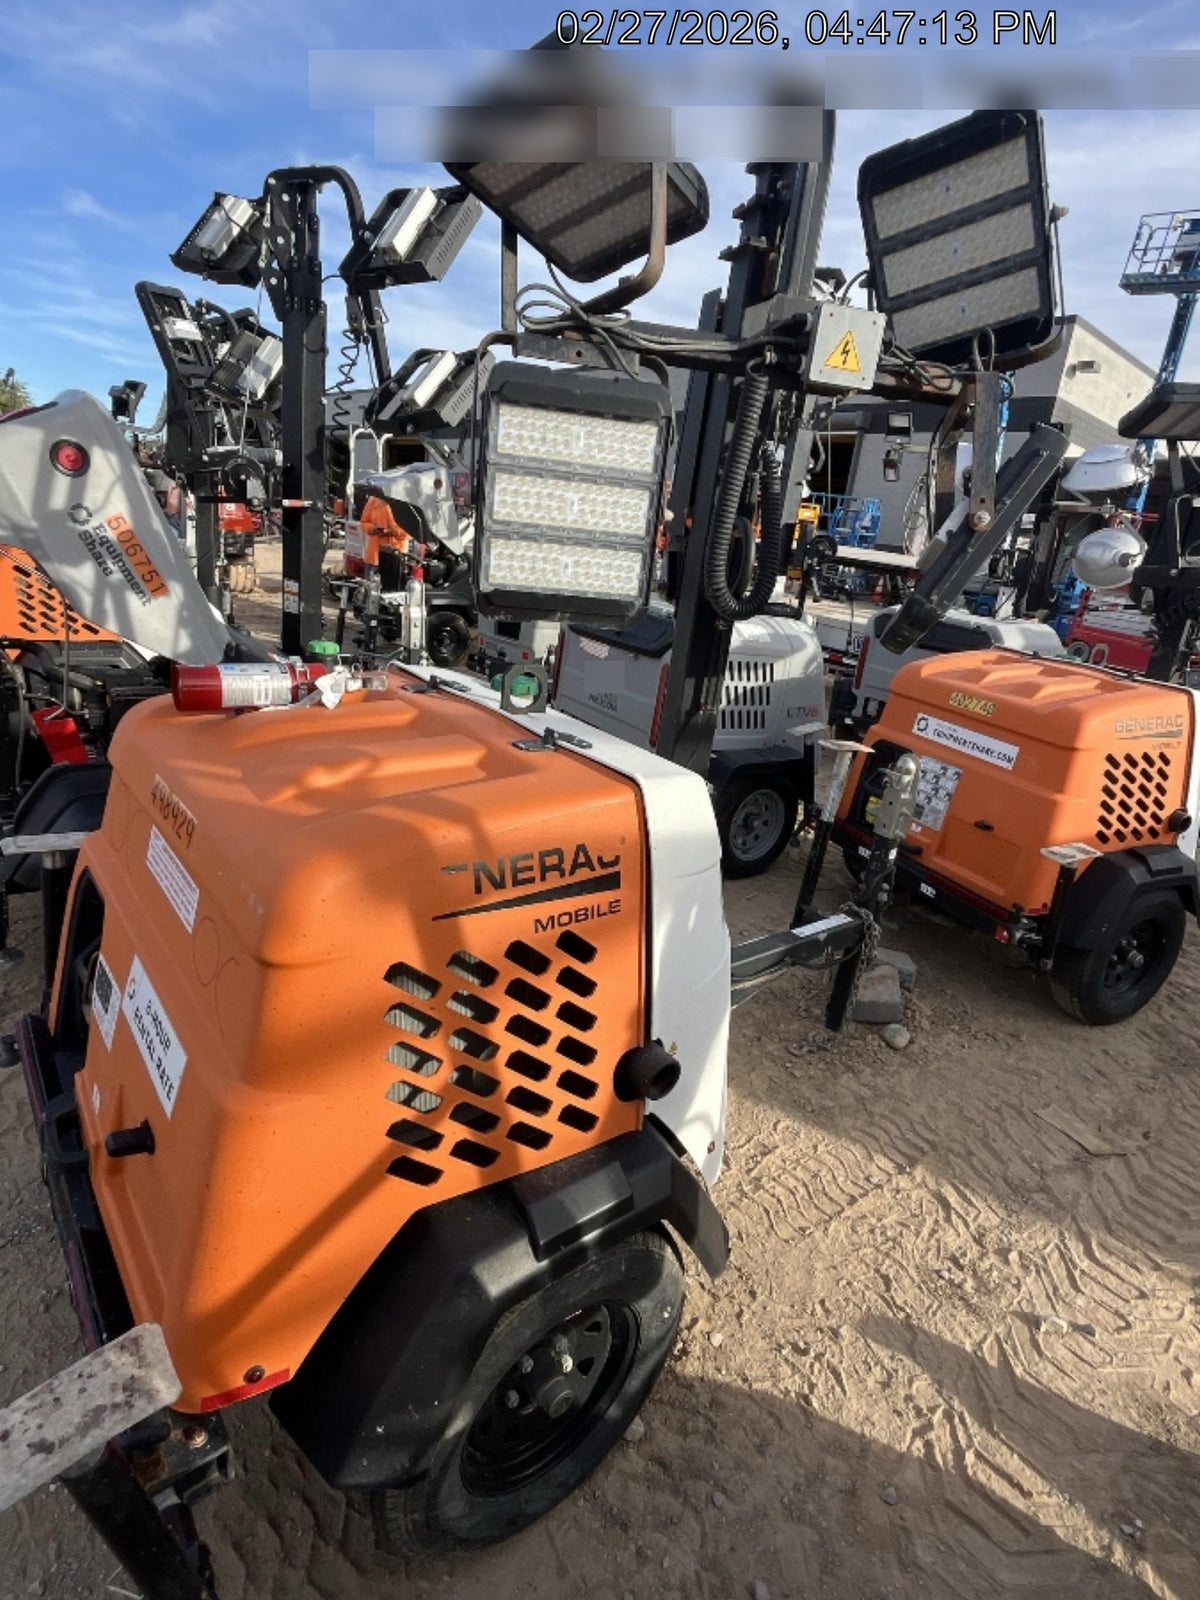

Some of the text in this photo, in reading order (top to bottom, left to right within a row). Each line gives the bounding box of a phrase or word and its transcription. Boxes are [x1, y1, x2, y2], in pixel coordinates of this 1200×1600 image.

[78, 529, 113, 577] Share
[92, 522, 152, 607] Equipment
[107, 516, 167, 594] 506751
[1114, 714, 1184, 733] GENERAC
[533, 899, 622, 934] MOBILE
